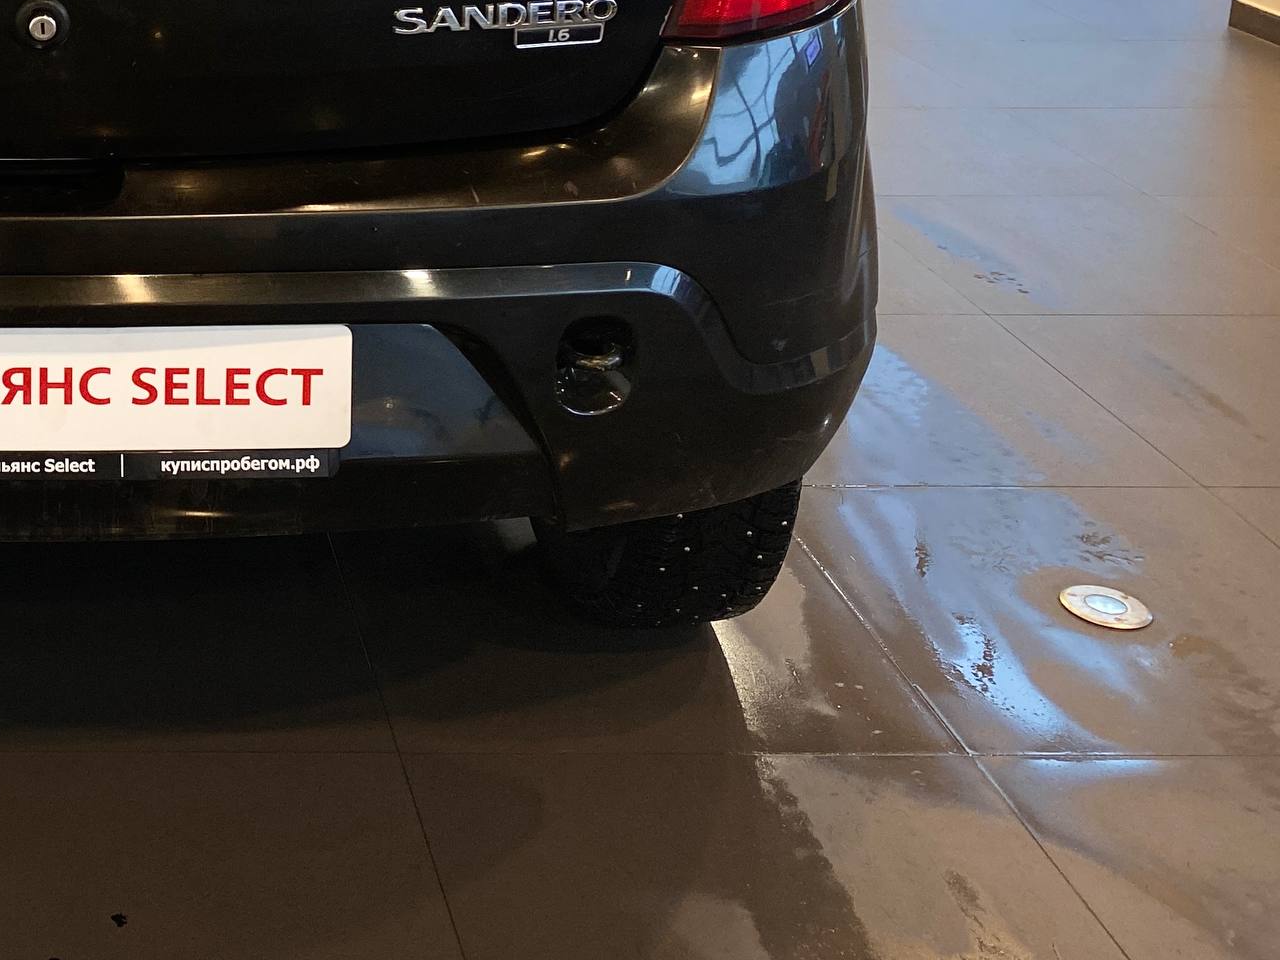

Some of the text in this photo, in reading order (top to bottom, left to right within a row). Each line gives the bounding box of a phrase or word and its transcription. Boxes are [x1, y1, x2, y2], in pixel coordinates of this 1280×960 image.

[547, 28, 570, 42] 1.6
[131, 366, 324, 407] SELECT
[44, 458, 96, 473] Select
[160, 454, 321, 475] куписпробегом.рф
